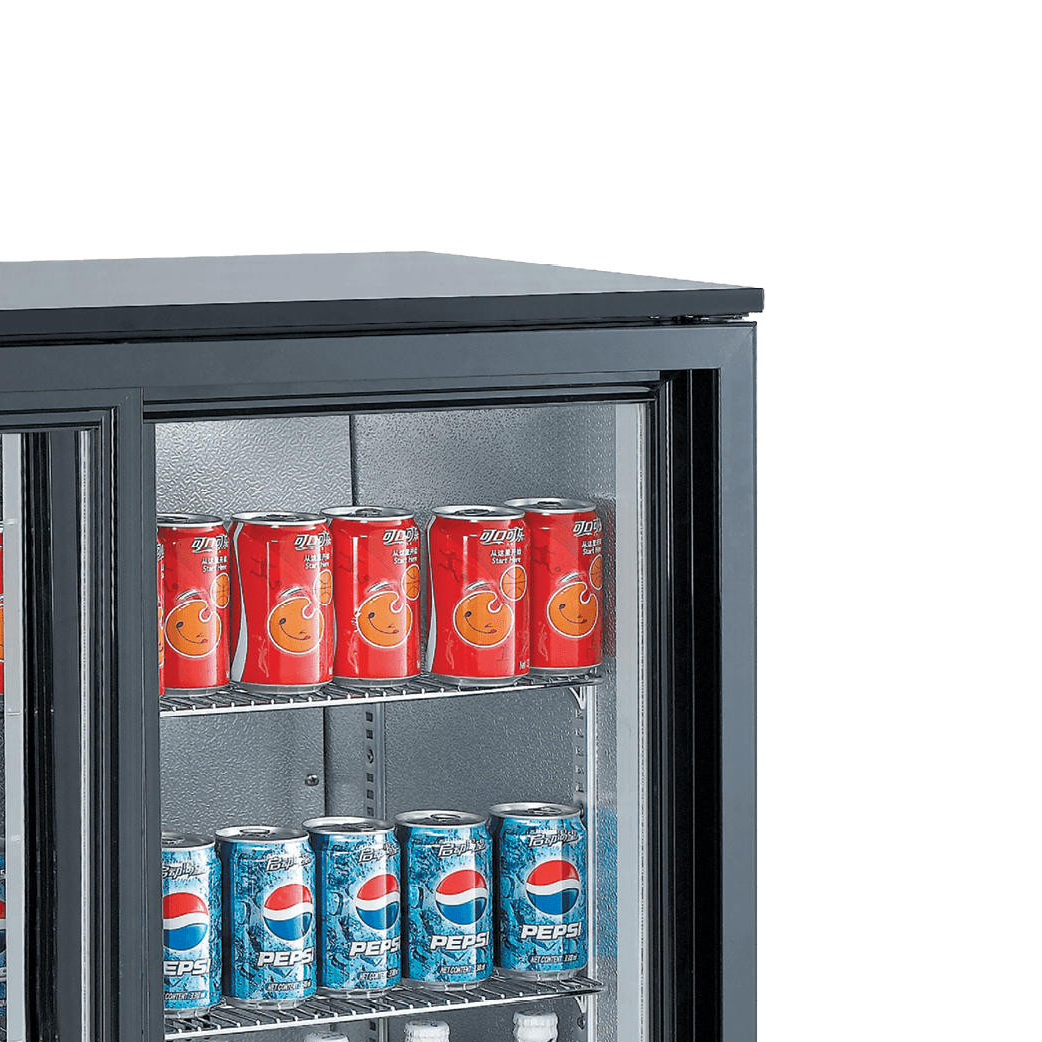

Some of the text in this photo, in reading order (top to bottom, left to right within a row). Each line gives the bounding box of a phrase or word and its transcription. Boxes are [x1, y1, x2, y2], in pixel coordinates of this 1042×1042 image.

[521, 921, 583, 940] PEPSI
[349, 936, 400, 957] PEPS
[164, 959, 211, 977] EPSI
